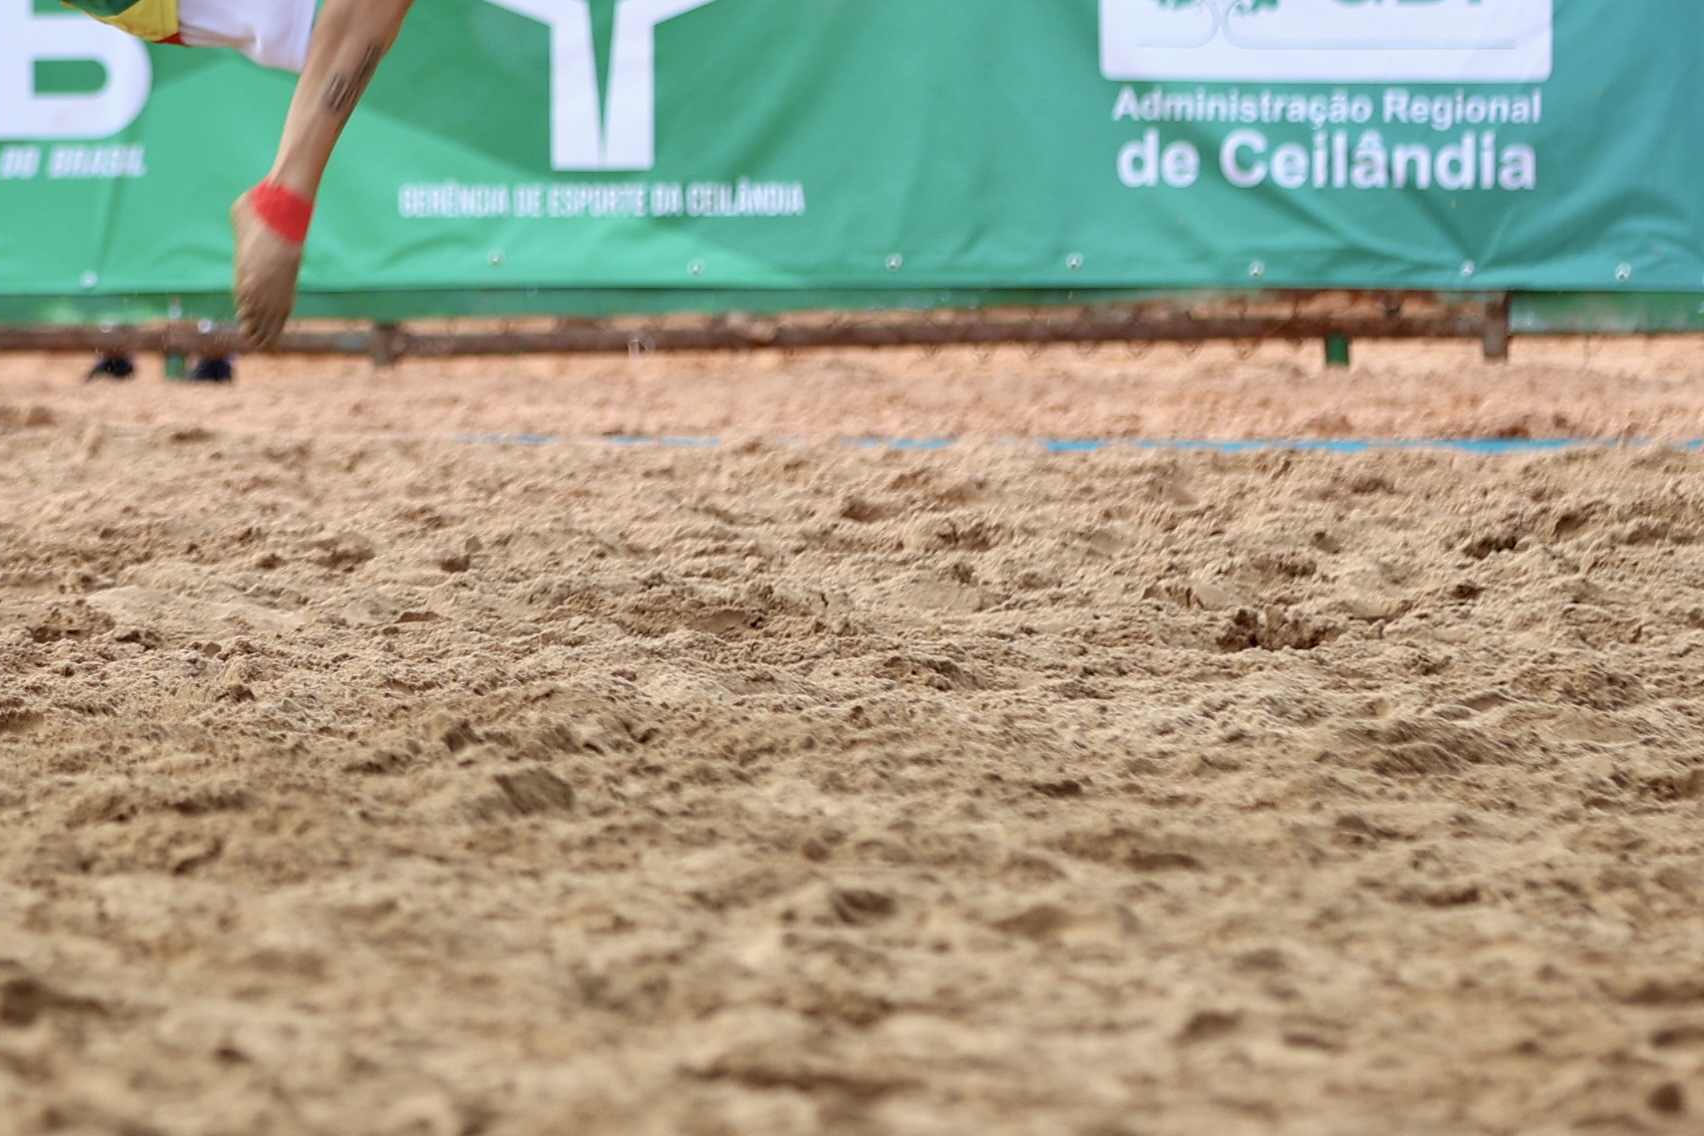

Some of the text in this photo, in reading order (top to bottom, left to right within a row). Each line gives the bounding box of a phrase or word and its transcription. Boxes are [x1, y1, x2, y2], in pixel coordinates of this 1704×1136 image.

[1112, 86, 1543, 131] Administração Regional
[47, 144, 145, 179] BRASIL
[1116, 127, 1537, 192] de Ceilândia
[512, 183, 545, 217] DE
[546, 182, 650, 217] ESPORTE
[650, 182, 685, 217] DA
[686, 175, 806, 217] CEILÂNDIA
